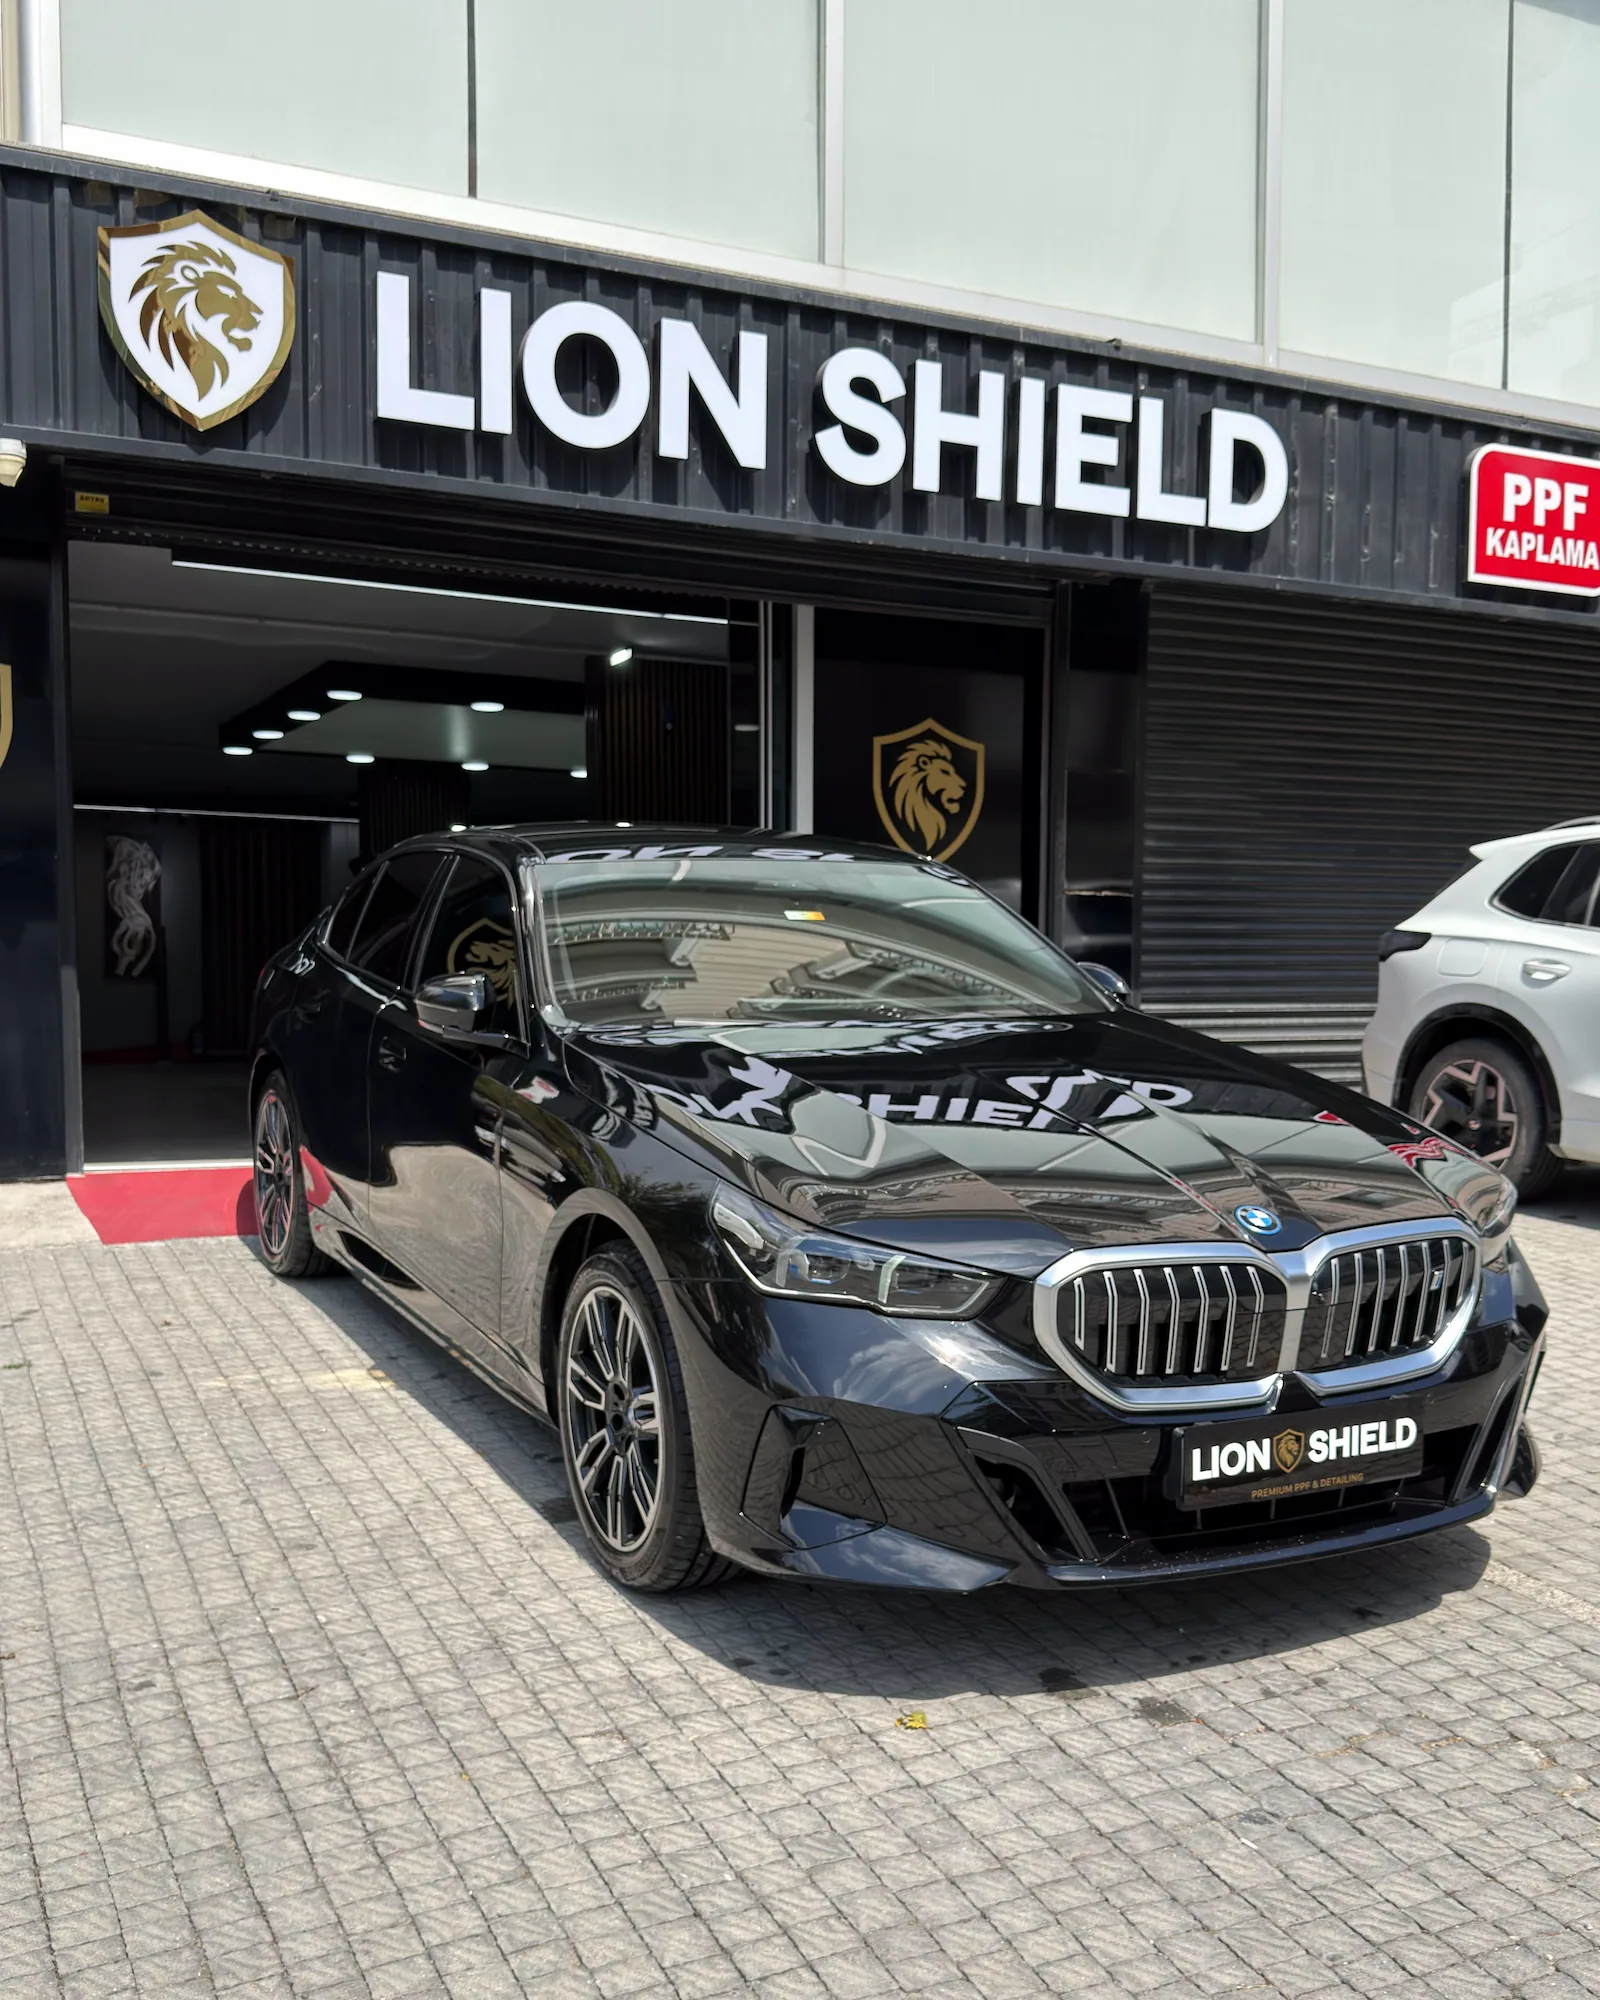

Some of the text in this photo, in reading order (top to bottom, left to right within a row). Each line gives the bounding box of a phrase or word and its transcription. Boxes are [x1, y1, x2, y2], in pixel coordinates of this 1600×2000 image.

[376, 270, 1289, 533] LION SHIELD
[1503, 472, 1590, 531] PPF
[1486, 527, 1600, 571] KAPLAMA
[1192, 1416, 1418, 1482] LION SHIELD
[1251, 1472, 1364, 1499] PREMIUM PPF & DETAILING
